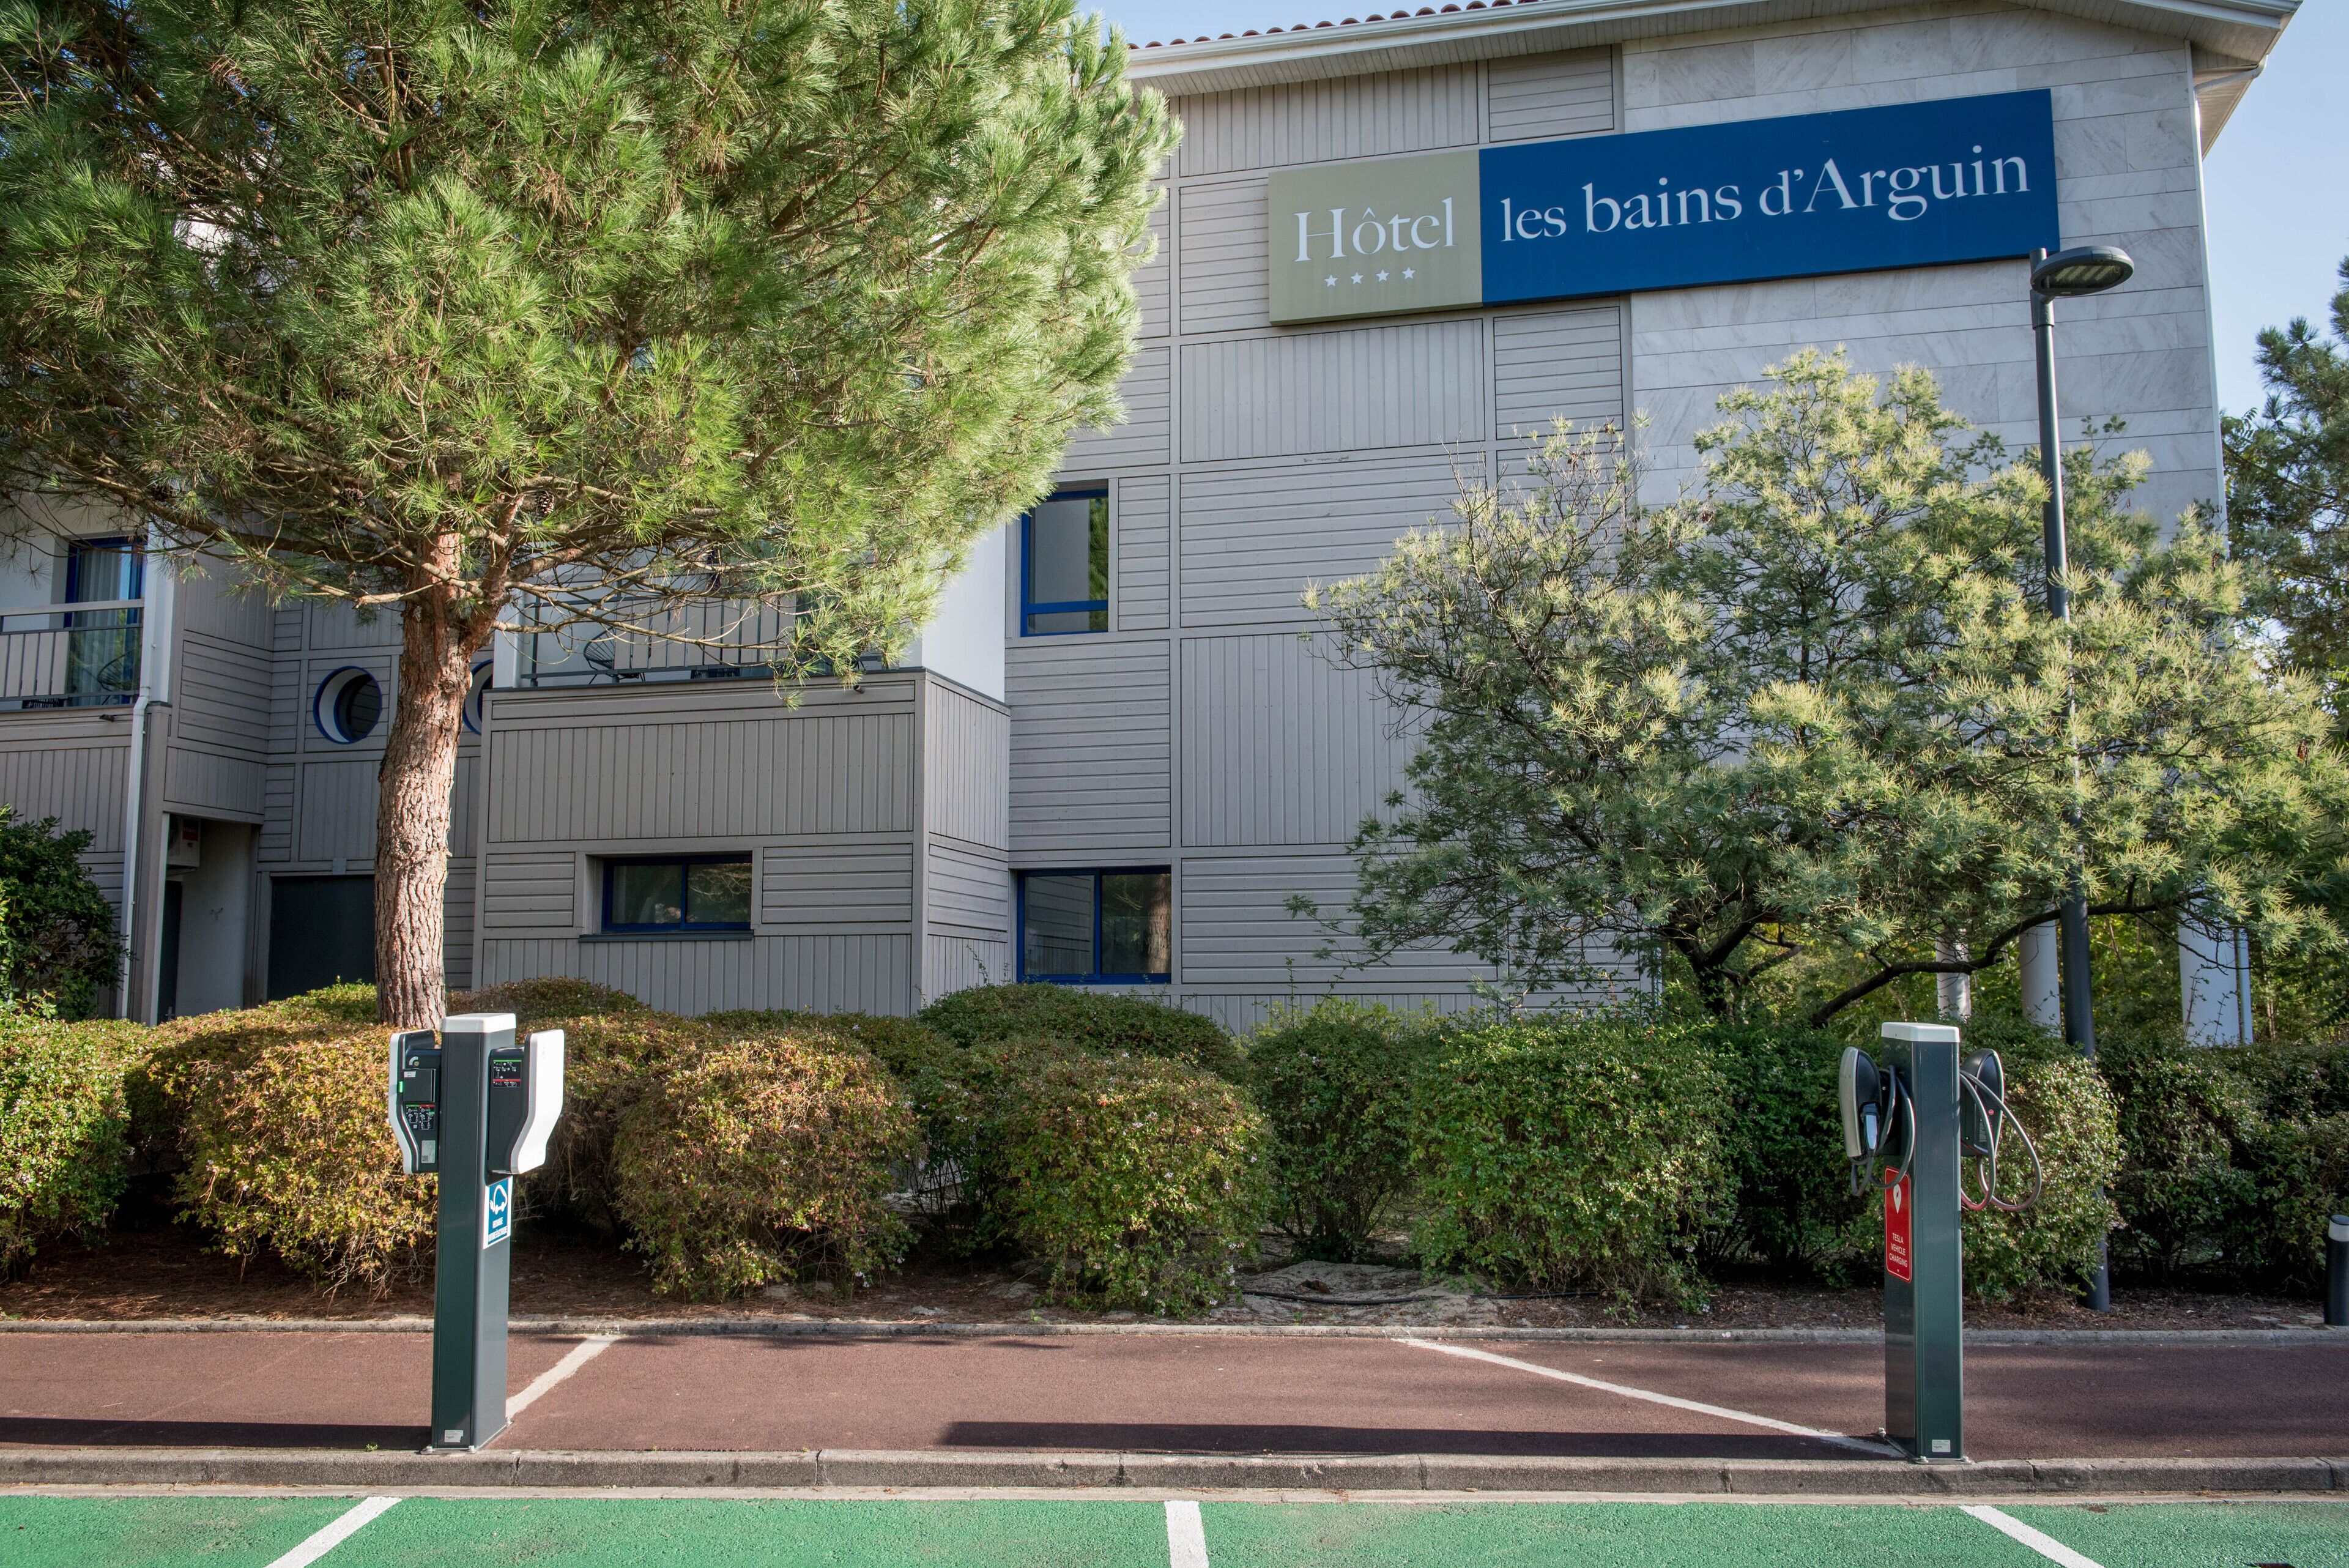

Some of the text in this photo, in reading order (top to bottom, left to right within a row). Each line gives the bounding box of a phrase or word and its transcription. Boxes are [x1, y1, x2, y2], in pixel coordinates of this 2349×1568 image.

[1501, 145, 2030, 242] les bains d'Arguin
[1293, 196, 1456, 262] Hôtel
[1892, 1233, 1904, 1244] TESLA
[1890, 1243, 1906, 1256] VEHICLE
[1888, 1252, 1908, 1268] CHARGING
